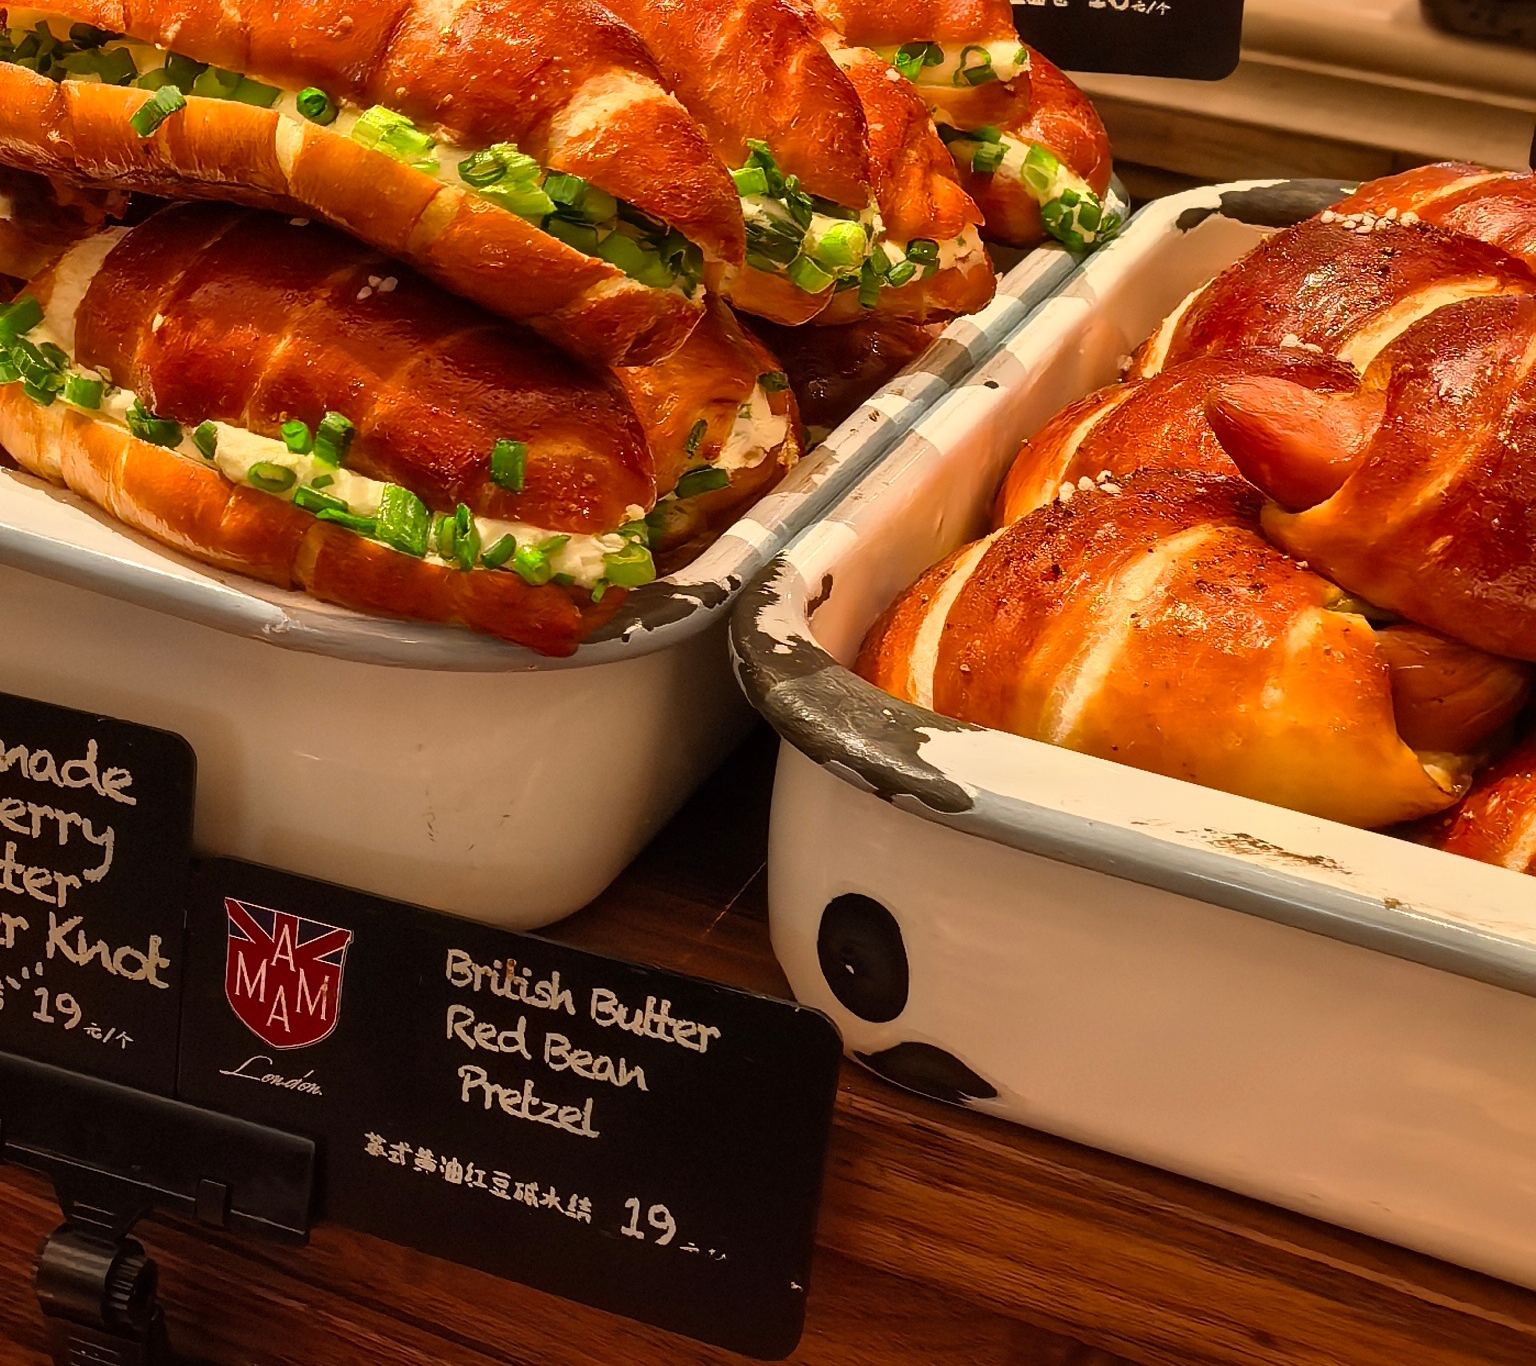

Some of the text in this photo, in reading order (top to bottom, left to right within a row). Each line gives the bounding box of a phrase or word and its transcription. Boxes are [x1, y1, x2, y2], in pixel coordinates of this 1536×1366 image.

[46, 912, 171, 989] Knot
[444, 947, 722, 1054] British Butter
[445, 1003, 649, 1092] Red Bean
[456, 1064, 600, 1139] Pretzel
